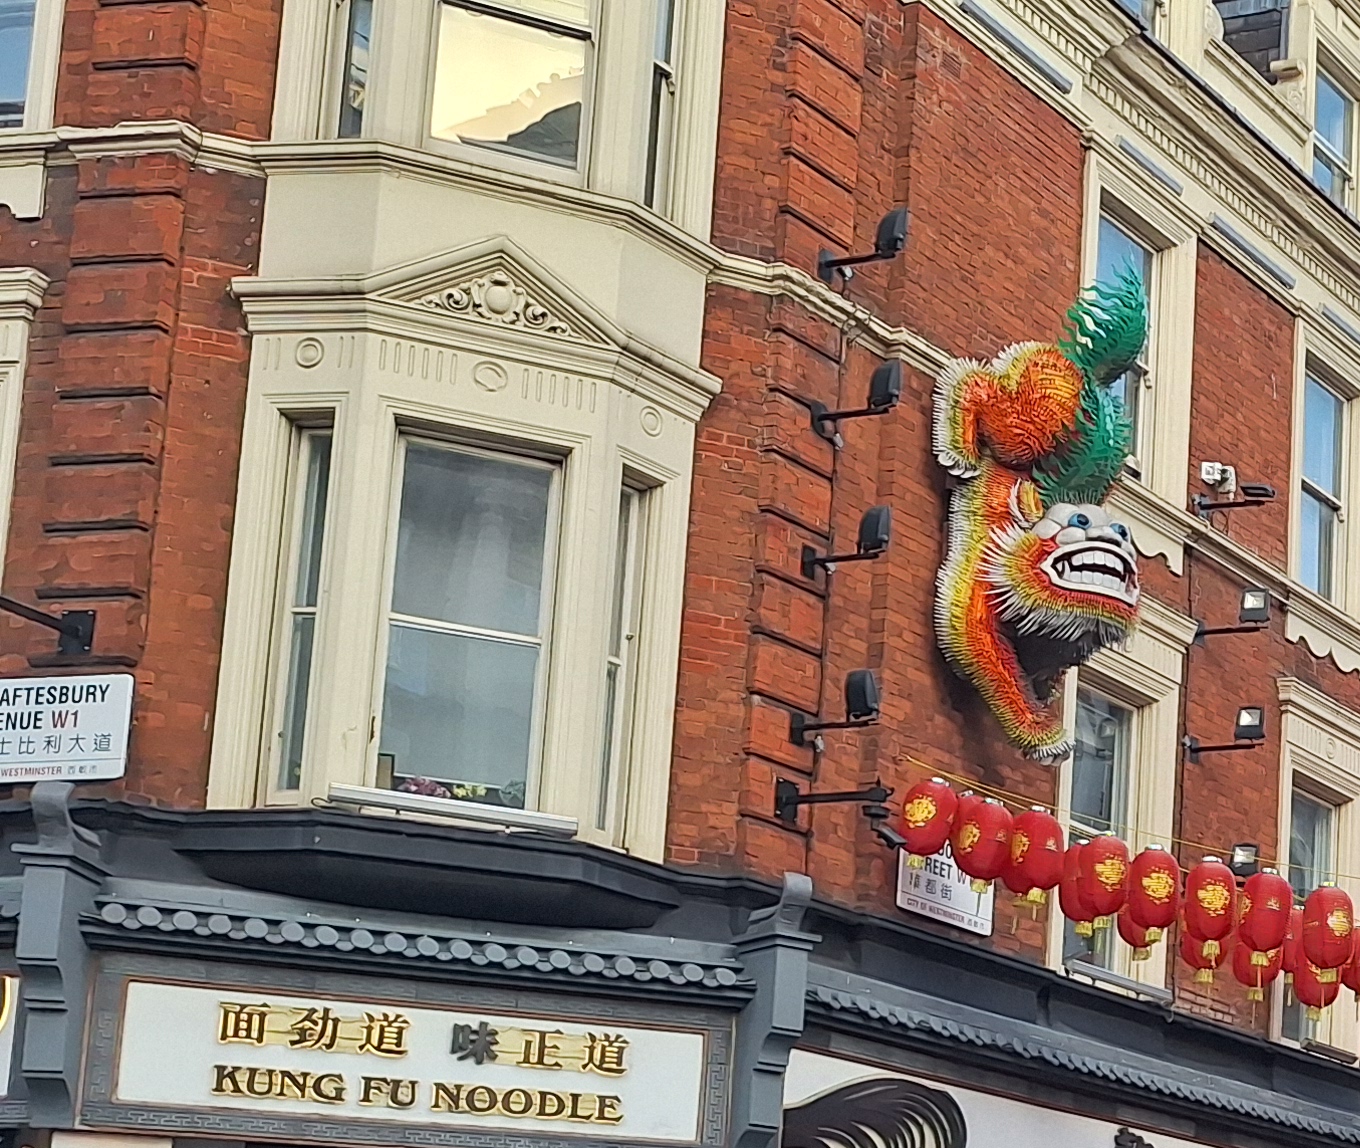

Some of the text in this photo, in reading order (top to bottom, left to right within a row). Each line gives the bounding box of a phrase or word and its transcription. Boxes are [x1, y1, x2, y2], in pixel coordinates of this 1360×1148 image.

[51, 709, 79, 729] W1
[0, 765, 62, 777] WESTMINSTER
[921, 856, 953, 881] REET
[217, 1002, 630, 1077] 面劲道 味正道
[211, 1063, 627, 1125] KUNG FU NOODLE
